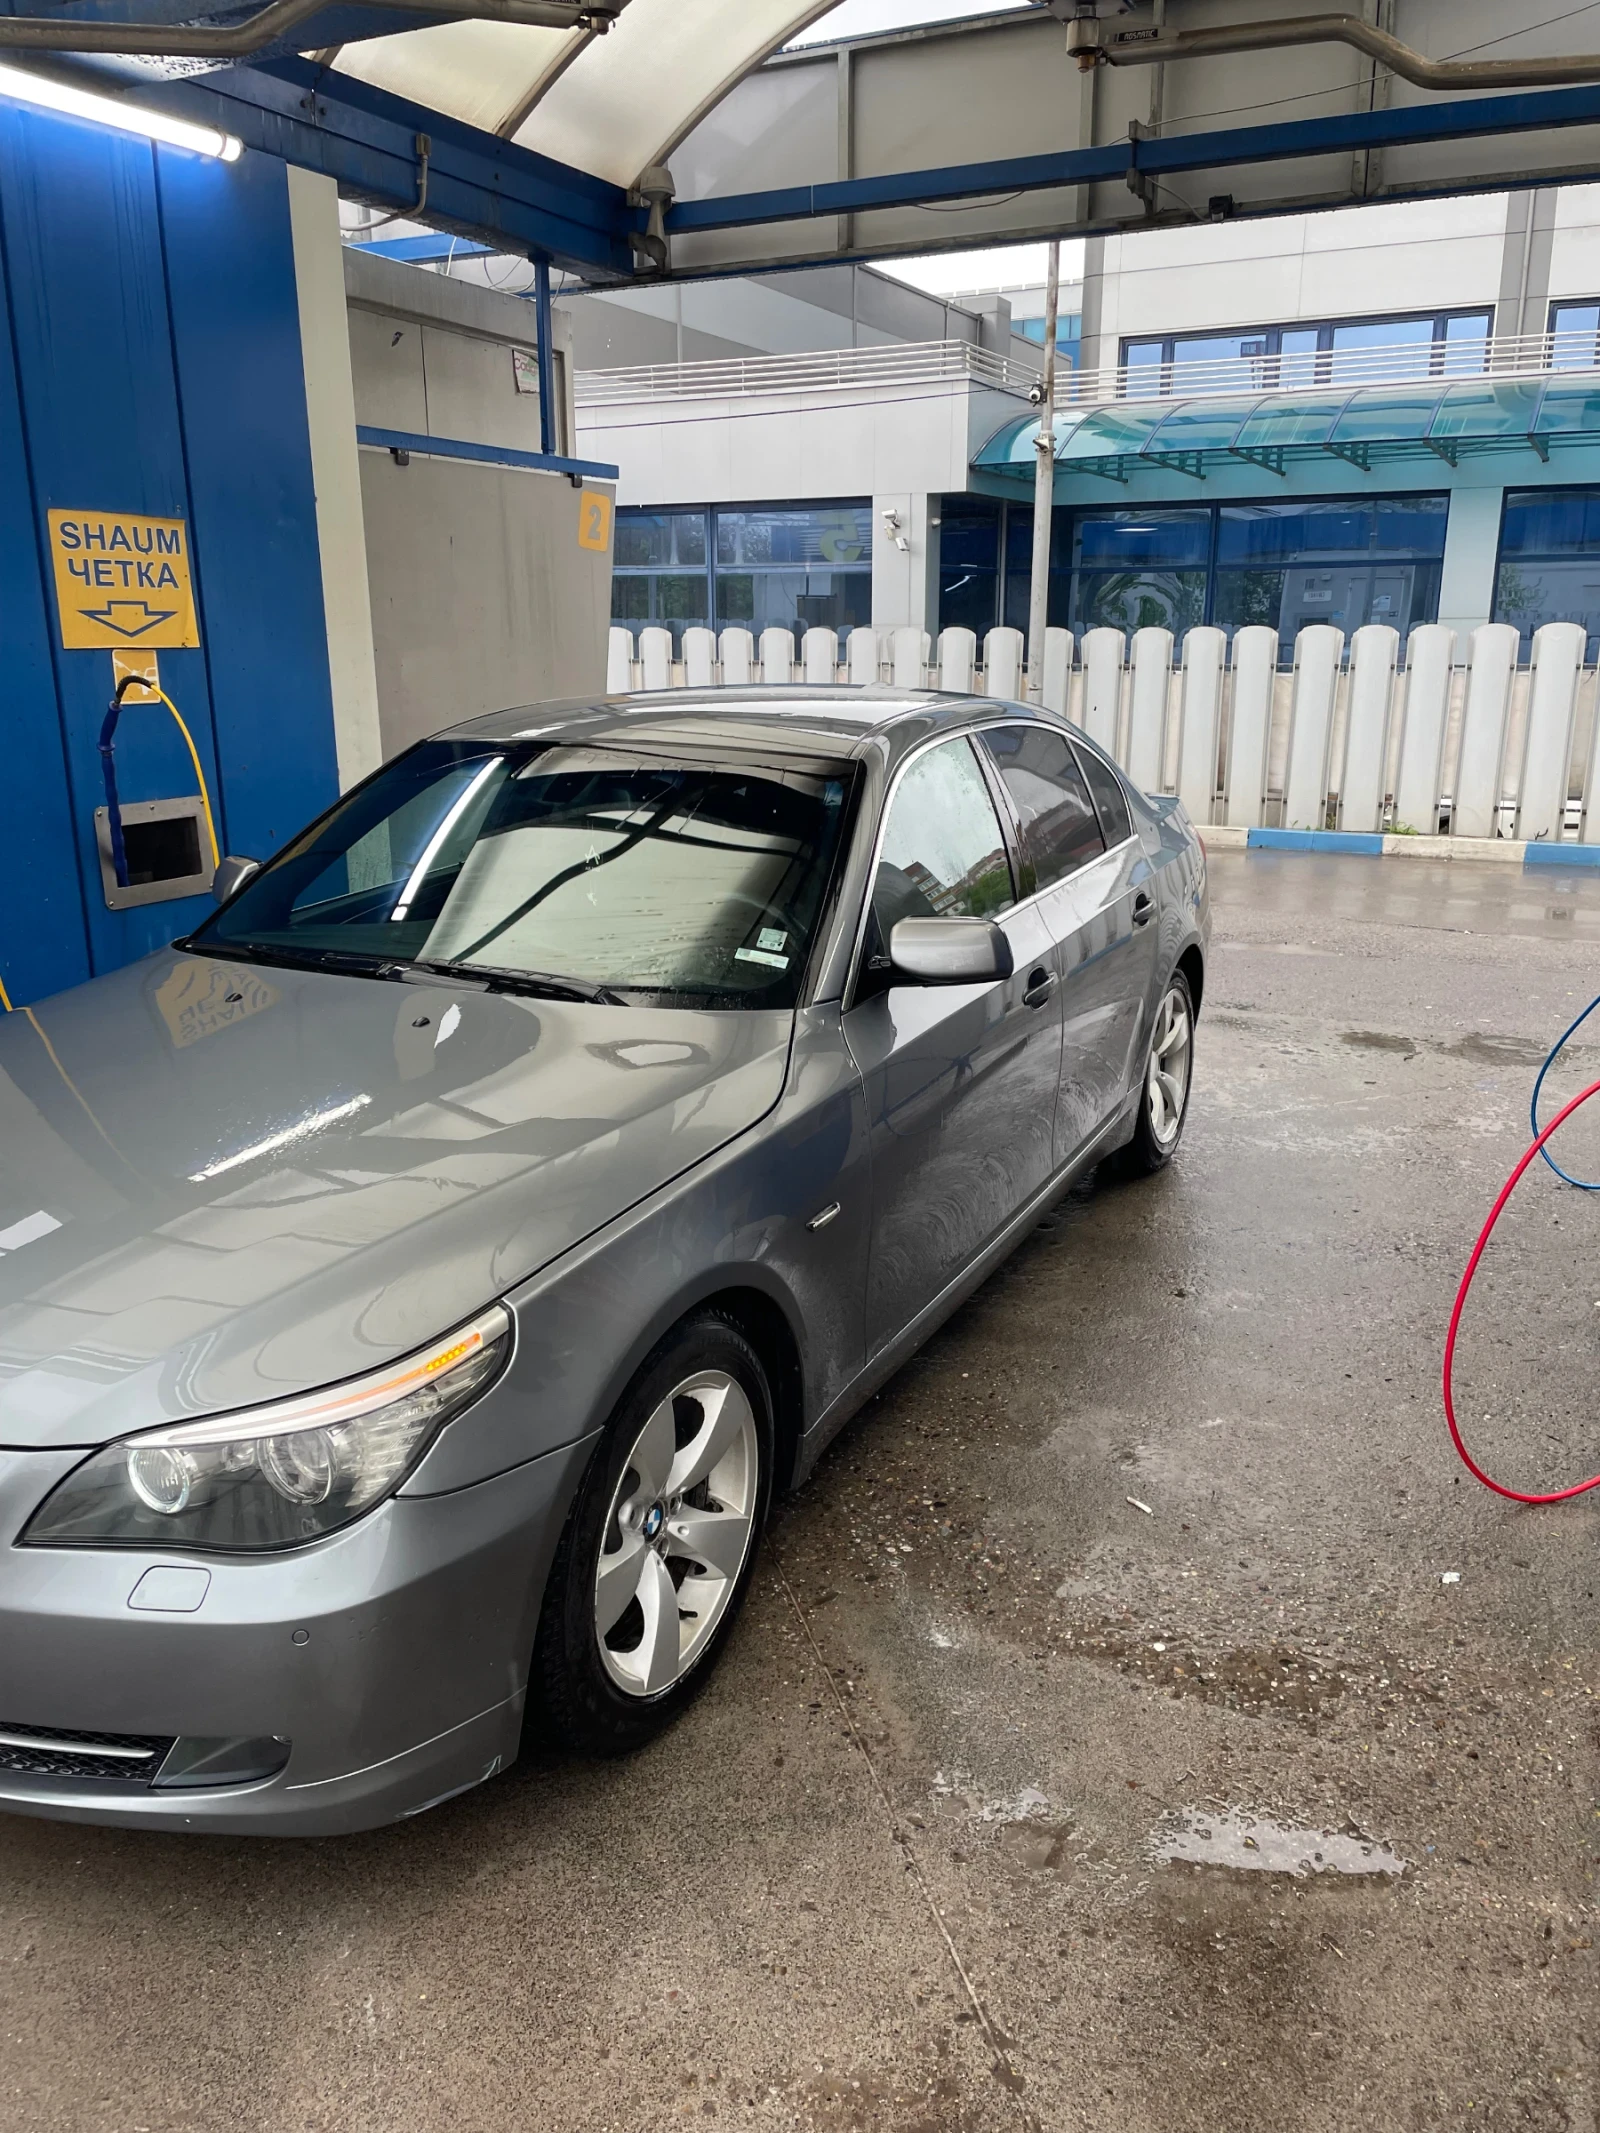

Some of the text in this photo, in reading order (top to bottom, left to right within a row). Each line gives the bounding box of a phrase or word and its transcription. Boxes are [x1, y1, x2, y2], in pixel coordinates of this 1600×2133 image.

[59, 521, 181, 555] SHAUM
[586, 504, 602, 541] 2
[67, 558, 180, 589] ЧЕТКА
